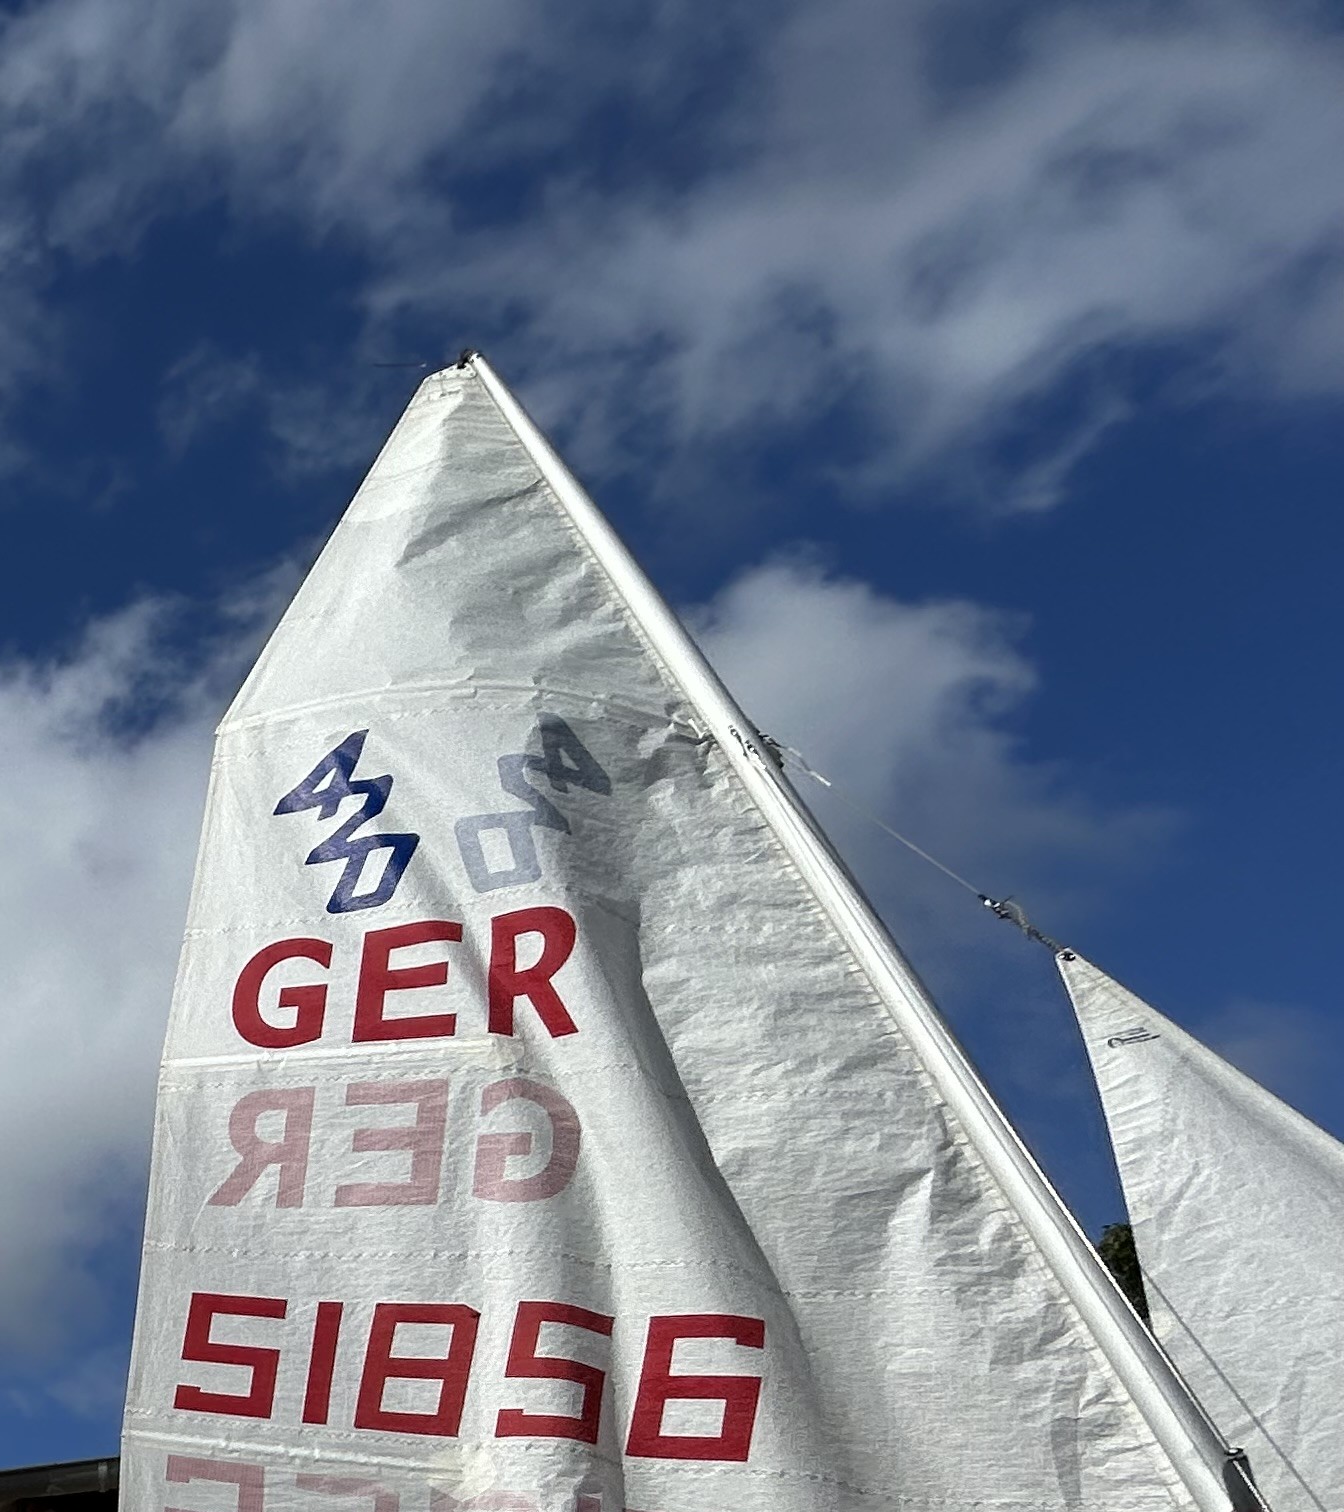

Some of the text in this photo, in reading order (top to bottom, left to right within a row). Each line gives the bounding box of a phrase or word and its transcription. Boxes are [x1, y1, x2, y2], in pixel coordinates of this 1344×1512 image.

[272, 729, 419, 914] 420
[230, 905, 579, 1050] GER
[173, 1292, 765, 1462] 51856
